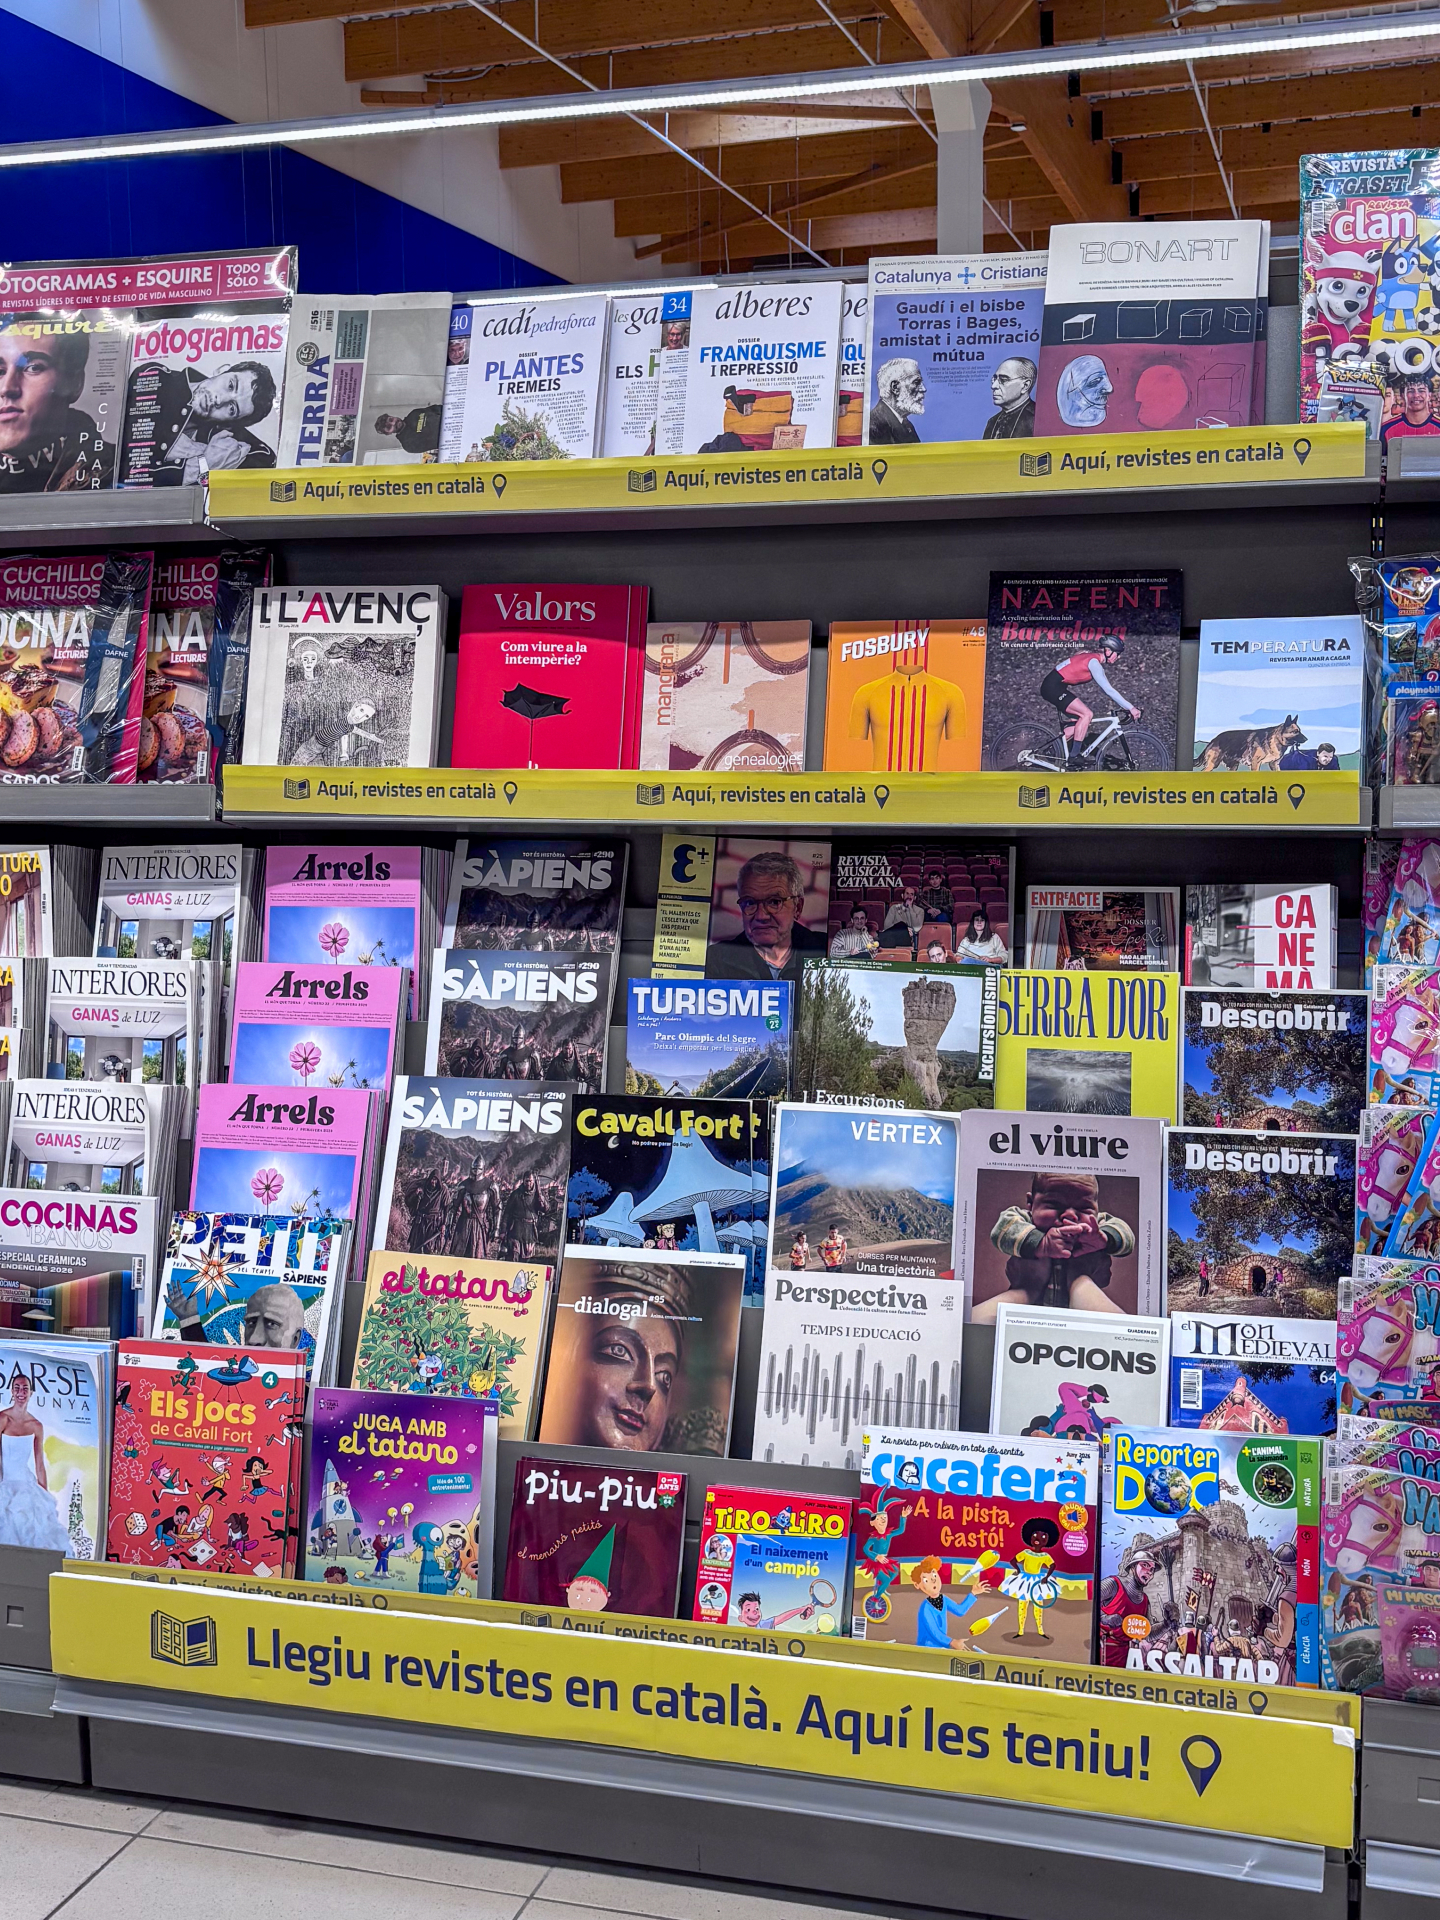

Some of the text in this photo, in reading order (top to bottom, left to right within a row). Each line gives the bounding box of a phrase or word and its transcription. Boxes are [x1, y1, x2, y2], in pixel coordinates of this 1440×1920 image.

[1330, 207, 1417, 242] clan
[1080, 238, 1238, 265] BONART
[136, 266, 213, 288] ESQUIRE
[226, 263, 261, 275] TODO
[227, 275, 258, 287] SÓLO
[875, 264, 1048, 286] Catalunya Cristiana
[716, 290, 812, 320] alberes
[896, 298, 1025, 316] Gaudí i el bisbe
[483, 307, 596, 339] cadí pedraforca
[899, 314, 1022, 333] Torras i Bages,
[134, 323, 283, 361] Fotogramas
[880, 329, 1039, 348] amistat i admiració
[700, 341, 826, 363] FRANQUISME
[932, 348, 984, 363] mútua
[485, 353, 584, 382] PLANTES
[711, 358, 798, 377] I REPRESSIÓ
[498, 378, 561, 395] I REMEIS
[296, 355, 330, 465] TERRA
[1060, 441, 1284, 473] Aquí, revistes en català
[303, 476, 484, 501] Aquí, revistes en català
[664, 461, 863, 493] Aquí, revistes en català
[3, 564, 105, 584] CUCHILLO
[6, 584, 100, 601] MULTIUSOS
[1002, 586, 1168, 609] NAFENT
[278, 592, 430, 637] L'AVENÇ
[495, 591, 596, 622] Valors
[500, 640, 587, 653] Com viure a la
[840, 627, 931, 662] FOSBURY
[1211, 638, 1350, 654] TEMPERATURA
[505, 653, 582, 667] intempèrie?
[656, 633, 677, 726] mangrana
[317, 781, 496, 800] Aquí, revistes en català
[672, 783, 865, 806] Aquí, revistes en català
[1058, 784, 1278, 808] Aquí, revistes en català
[105, 855, 237, 881] INTERIORES
[293, 852, 390, 881] Arrels
[461, 850, 612, 890] SÀPIENS
[837, 856, 889, 866] REVISTA
[837, 866, 893, 877] MUSICAL
[837, 877, 904, 888] CATALANA
[1275, 894, 1316, 928] CA
[1279, 933, 1315, 967] NE
[51, 969, 187, 997] INTERIORES
[266, 971, 369, 1000] Arrels
[443, 960, 598, 1003] SÀPIENS
[633, 987, 780, 1017] TURISME
[1107, 978, 1169, 1041] D'OR
[72, 1007, 162, 1024] GANAS de LUZ
[978, 967, 996, 1081] Excursionisme
[1201, 1001, 1350, 1031] Descobrir
[655, 1032, 756, 1044] Parc Olímpic del Segre
[229, 1094, 335, 1126] Arrels
[402, 1087, 563, 1134] SÀPIENS
[577, 1107, 744, 1139] Cavall Fort
[989, 1124, 1129, 1160] el viure
[1185, 1144, 1338, 1176] Descobrir
[1, 1199, 138, 1235] COCINAS
[856, 1262, 936, 1277] Una trajectòria
[858, 1252, 937, 1264] CURSES PER MUNTANYA
[283, 1271, 327, 1285] SÀPIENS
[649, 1296, 665, 1304] #95
[775, 1279, 928, 1310] Perspectiva
[574, 1296, 647, 1320] dialogal
[801, 1324, 921, 1342] TEMPS I EDUCACIÓ
[1009, 1341, 1157, 1375] OPCIONS
[151, 1390, 256, 1426] Els jocs
[150, 1421, 252, 1443] de Cavall Fort
[353, 1413, 447, 1438] JUGA AMB
[339, 1431, 458, 1464] el tatano
[881, 1435, 892, 1444] La
[893, 1437, 918, 1447] revista
[919, 1439, 933, 1449] per
[934, 1441, 959, 1451] créixer
[971, 1444, 986, 1453] tots
[988, 1445, 998, 1454] els
[1000, 1447, 1024, 1457] sentits
[1116, 1435, 1217, 1468] Reporter
[871, 1453, 1086, 1505] cucafera
[914, 1496, 1015, 1528] A la pista,
[941, 1526, 1004, 1548] Gastó!
[751, 1545, 828, 1560] El naixement
[745, 1559, 820, 1578] d'un campió
[246, 1626, 1151, 1782] Llegiu revistes en català. Aquí les teniu!
